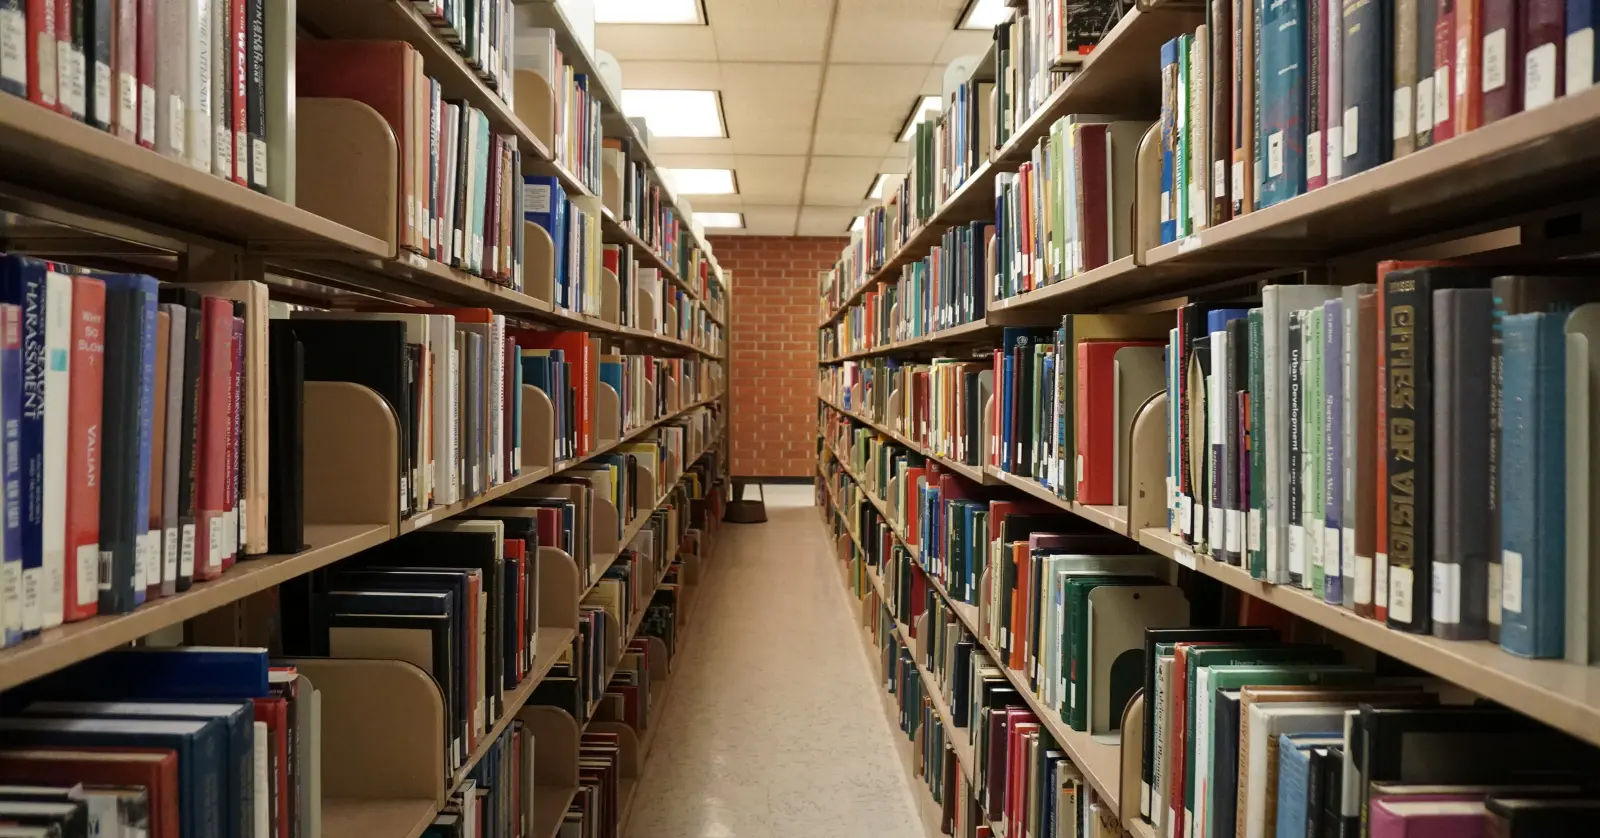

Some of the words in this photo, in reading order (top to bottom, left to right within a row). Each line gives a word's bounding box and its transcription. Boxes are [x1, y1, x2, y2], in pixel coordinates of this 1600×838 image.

[238, 33, 247, 97] WEAK
[82, 311, 102, 324] WHY
[85, 326, 99, 338] SO
[24, 281, 39, 420] HARASSMENT
[1391, 305, 1415, 410] CITIES
[86, 424, 98, 488] VALIAN
[1391, 418, 1415, 462] OF
[1391, 469, 1415, 568] VISIO
